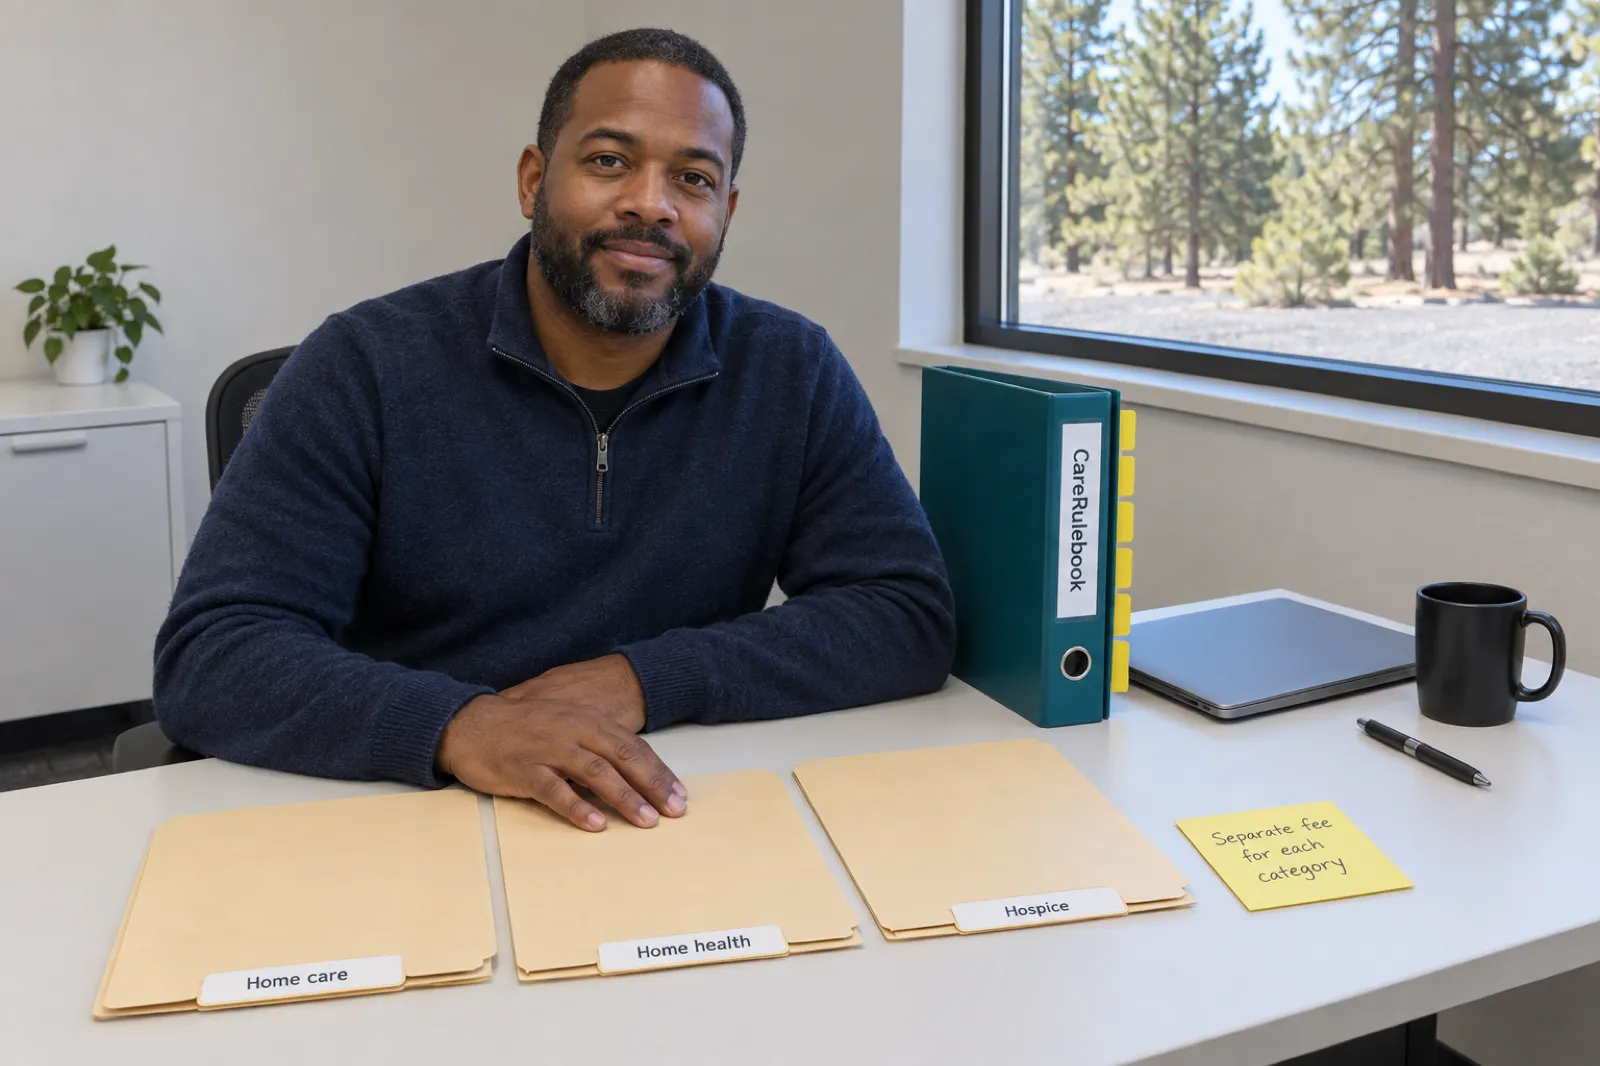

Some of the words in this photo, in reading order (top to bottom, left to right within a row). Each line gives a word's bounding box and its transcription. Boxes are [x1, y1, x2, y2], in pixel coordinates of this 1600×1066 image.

[1070, 448, 1089, 592] CareRulebook
[1211, 824, 1295, 846] Separate
[1301, 817, 1333, 832] fee
[1242, 848, 1271, 863] for
[1281, 838, 1325, 856] each
[1258, 857, 1348, 883] category
[1004, 901, 1070, 918] Hospice
[636, 944, 689, 959] Home
[694, 934, 751, 953] health
[246, 975, 301, 990] Home
[307, 970, 348, 984] care
